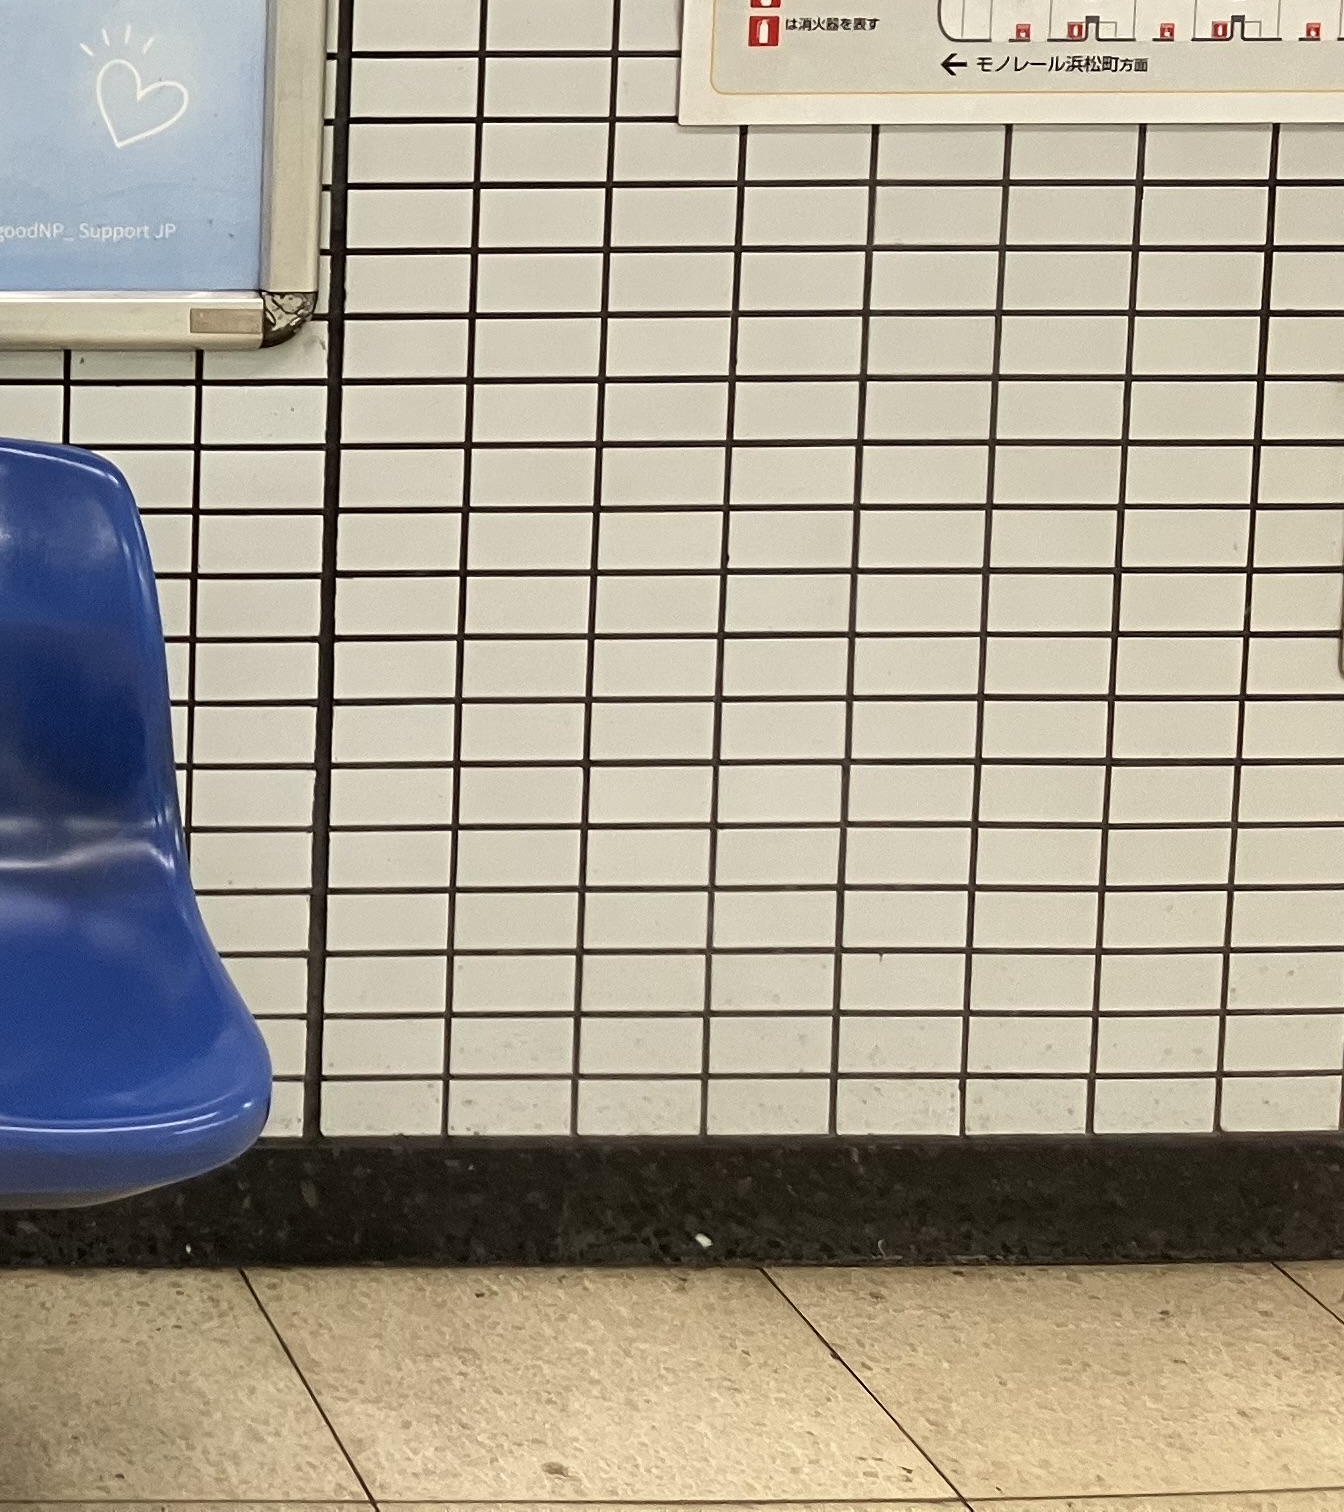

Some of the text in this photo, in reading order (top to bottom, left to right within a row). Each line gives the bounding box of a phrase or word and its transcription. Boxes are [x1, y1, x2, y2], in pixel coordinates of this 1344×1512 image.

[976, 54, 1149, 75] モノレール浜松町方面
[79, 223, 149, 242] Support
[155, 223, 177, 239] JP
